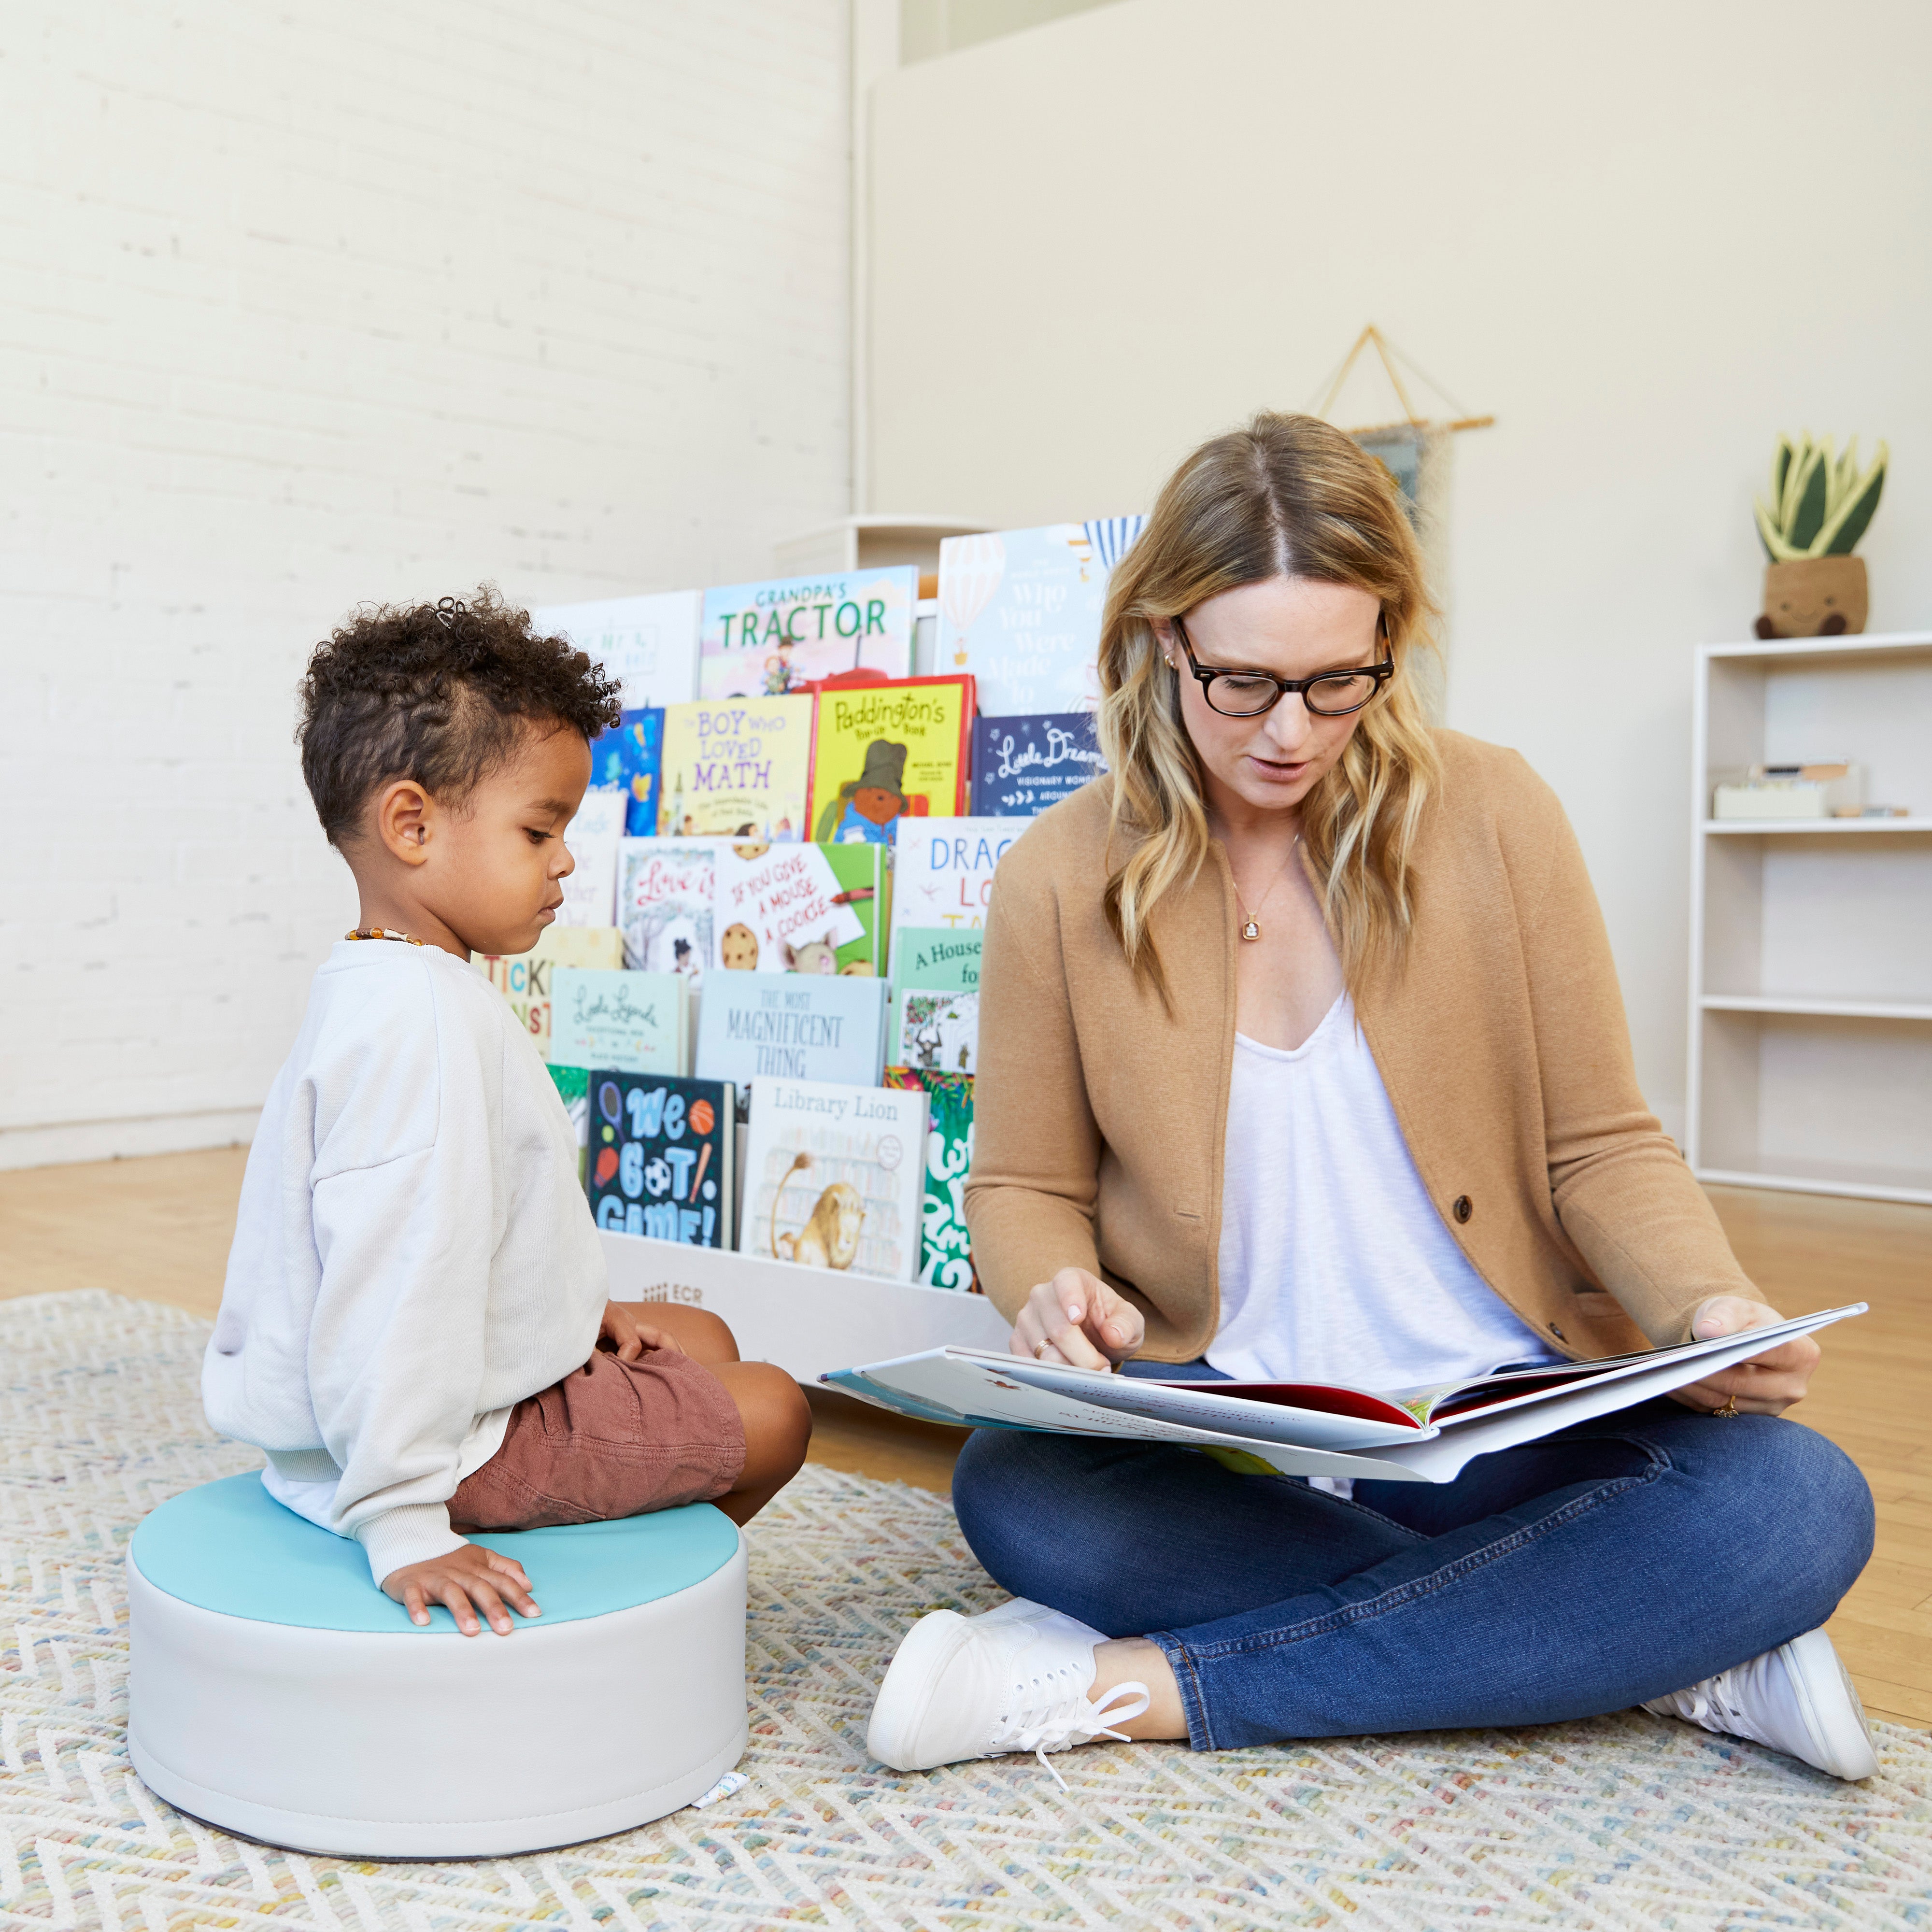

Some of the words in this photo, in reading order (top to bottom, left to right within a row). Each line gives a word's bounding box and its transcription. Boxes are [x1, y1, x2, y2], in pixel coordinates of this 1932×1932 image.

[756, 582, 846, 607] GRANDPA'S
[719, 599, 885, 648] TRACTOR
[698, 710, 747, 738] BOY
[835, 694, 945, 733] Paddington's
[701, 737, 762, 760] LOVED
[693, 760, 772, 791] MATH
[637, 860, 692, 907] Love
[747, 868, 771, 896] YOU
[773, 853, 809, 883] GIVE
[759, 901, 767, 919] A
[770, 877, 818, 912] MOUSE
[765, 928, 773, 944] A
[777, 896, 829, 938] COOKIE
[916, 953, 928, 971] A
[784, 990, 811, 1010] MOST
[727, 1008, 844, 1048] MAGNIFICENT
[755, 1044, 806, 1079] THING
[774, 1087, 847, 1120] Library
[854, 1094, 898, 1122] Lion
